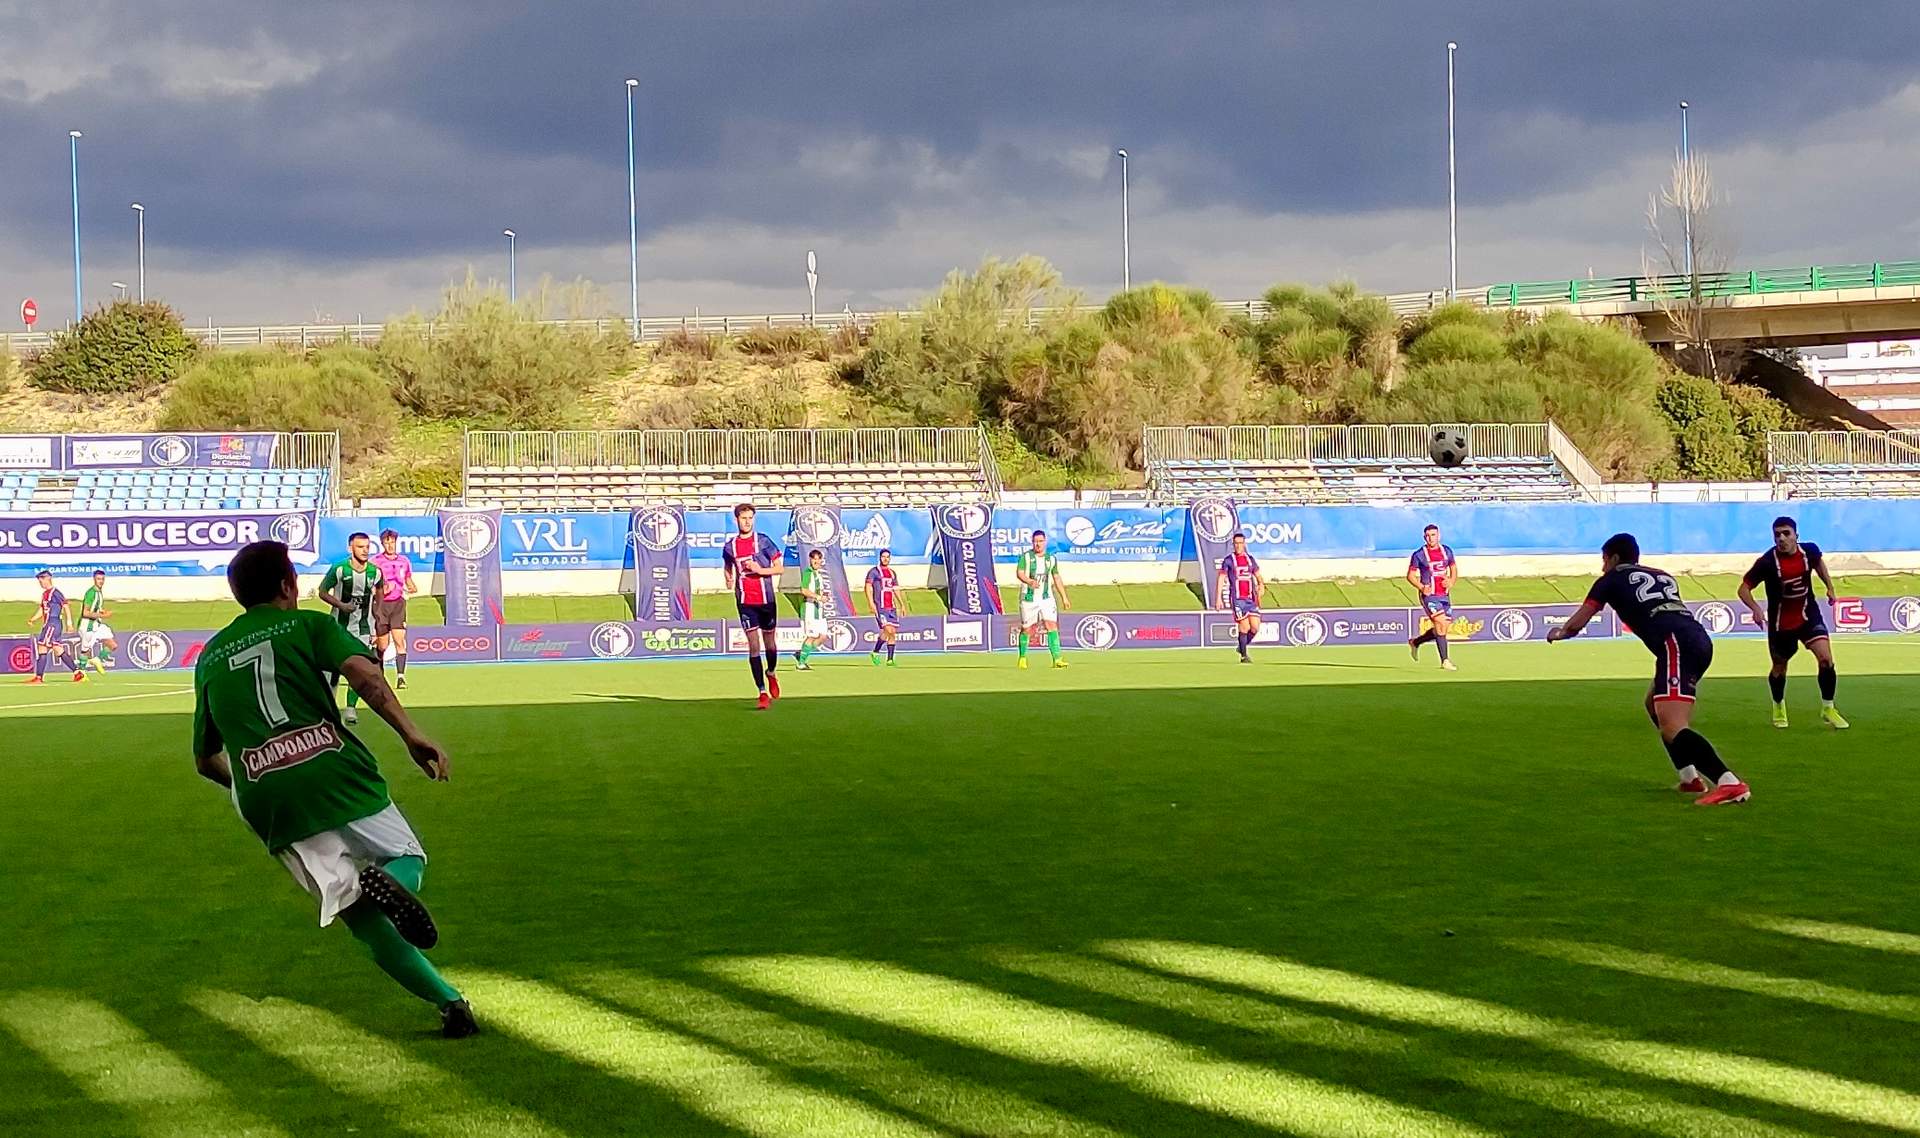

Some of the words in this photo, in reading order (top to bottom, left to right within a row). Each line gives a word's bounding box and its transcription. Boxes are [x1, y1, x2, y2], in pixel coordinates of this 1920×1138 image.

[27, 520, 259, 548] C.D.LUCECOR
[512, 518, 588, 551] VRL
[512, 556, 588, 566] ABOGADOS
[964, 562, 982, 613] LUCECOR
[1628, 571, 1680, 603] 22
[923, 630, 938, 640] SL
[1351, 623, 1375, 632] Juan
[1377, 622, 1404, 631] León
[413, 637, 490, 652] GOCCO
[228, 640, 290, 729] 7
[249, 726, 333, 772] CAMPOARAS
